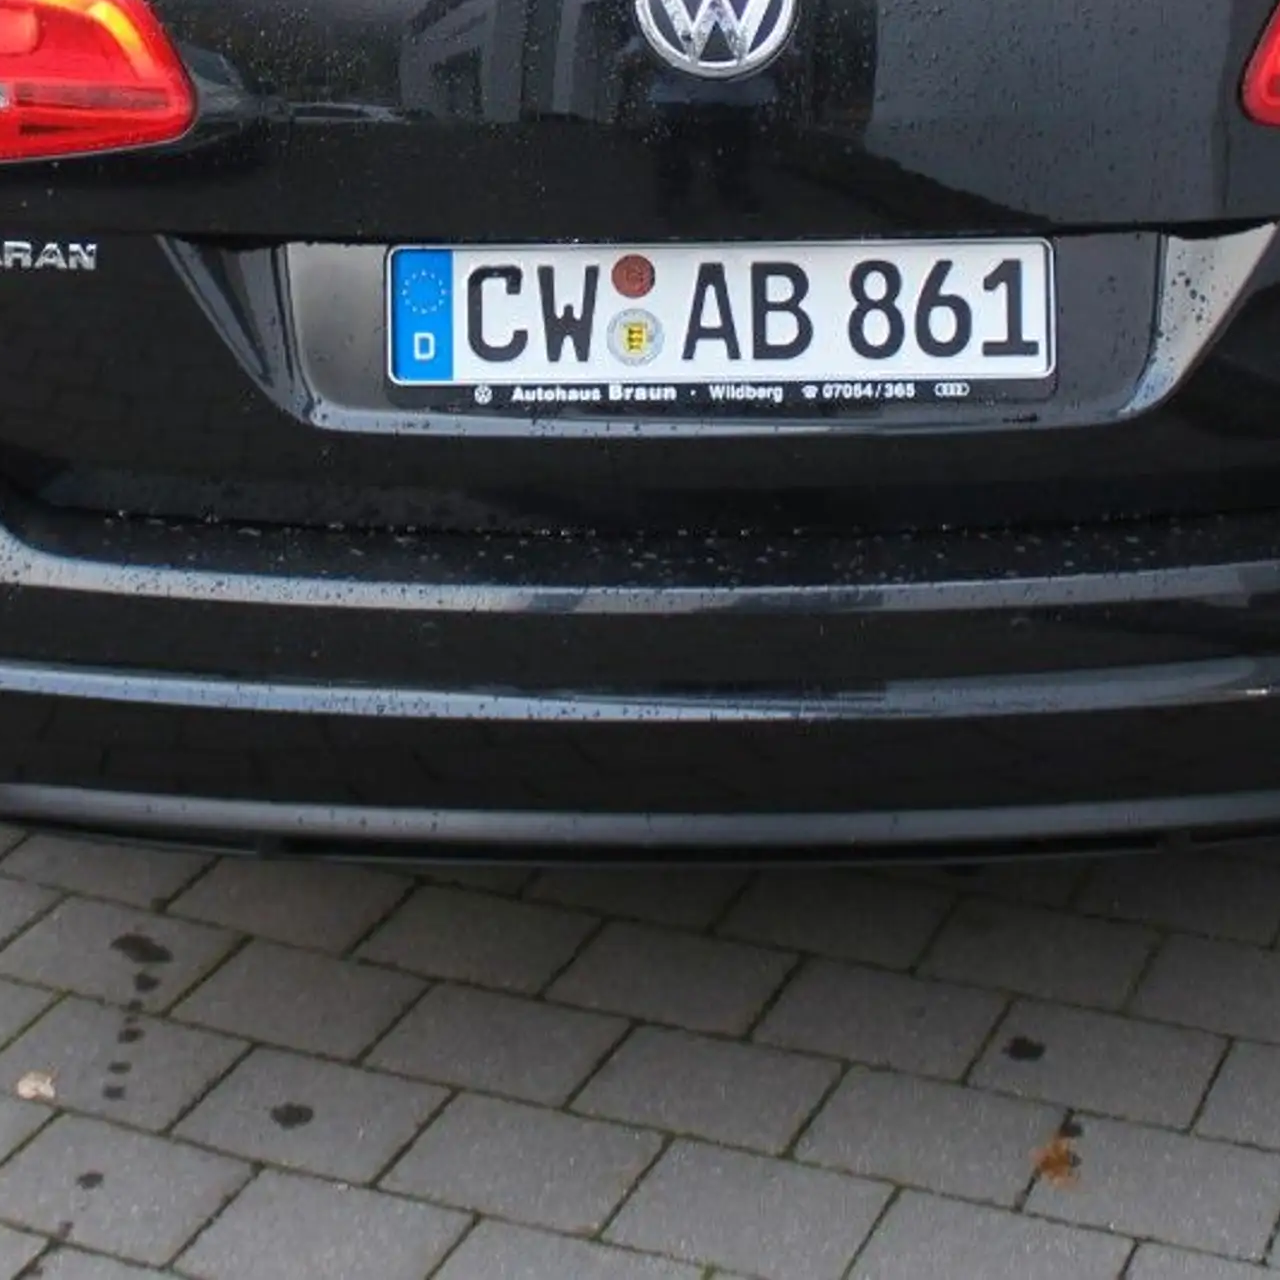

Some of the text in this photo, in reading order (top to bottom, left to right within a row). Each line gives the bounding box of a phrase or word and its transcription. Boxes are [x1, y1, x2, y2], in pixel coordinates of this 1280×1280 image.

[467, 258, 1039, 363] CW AB 861
[414, 331, 435, 361] D
[511, 386, 601, 402] Autohaus
[608, 384, 677, 402] Braun
[709, 384, 783, 402] Wildberg
